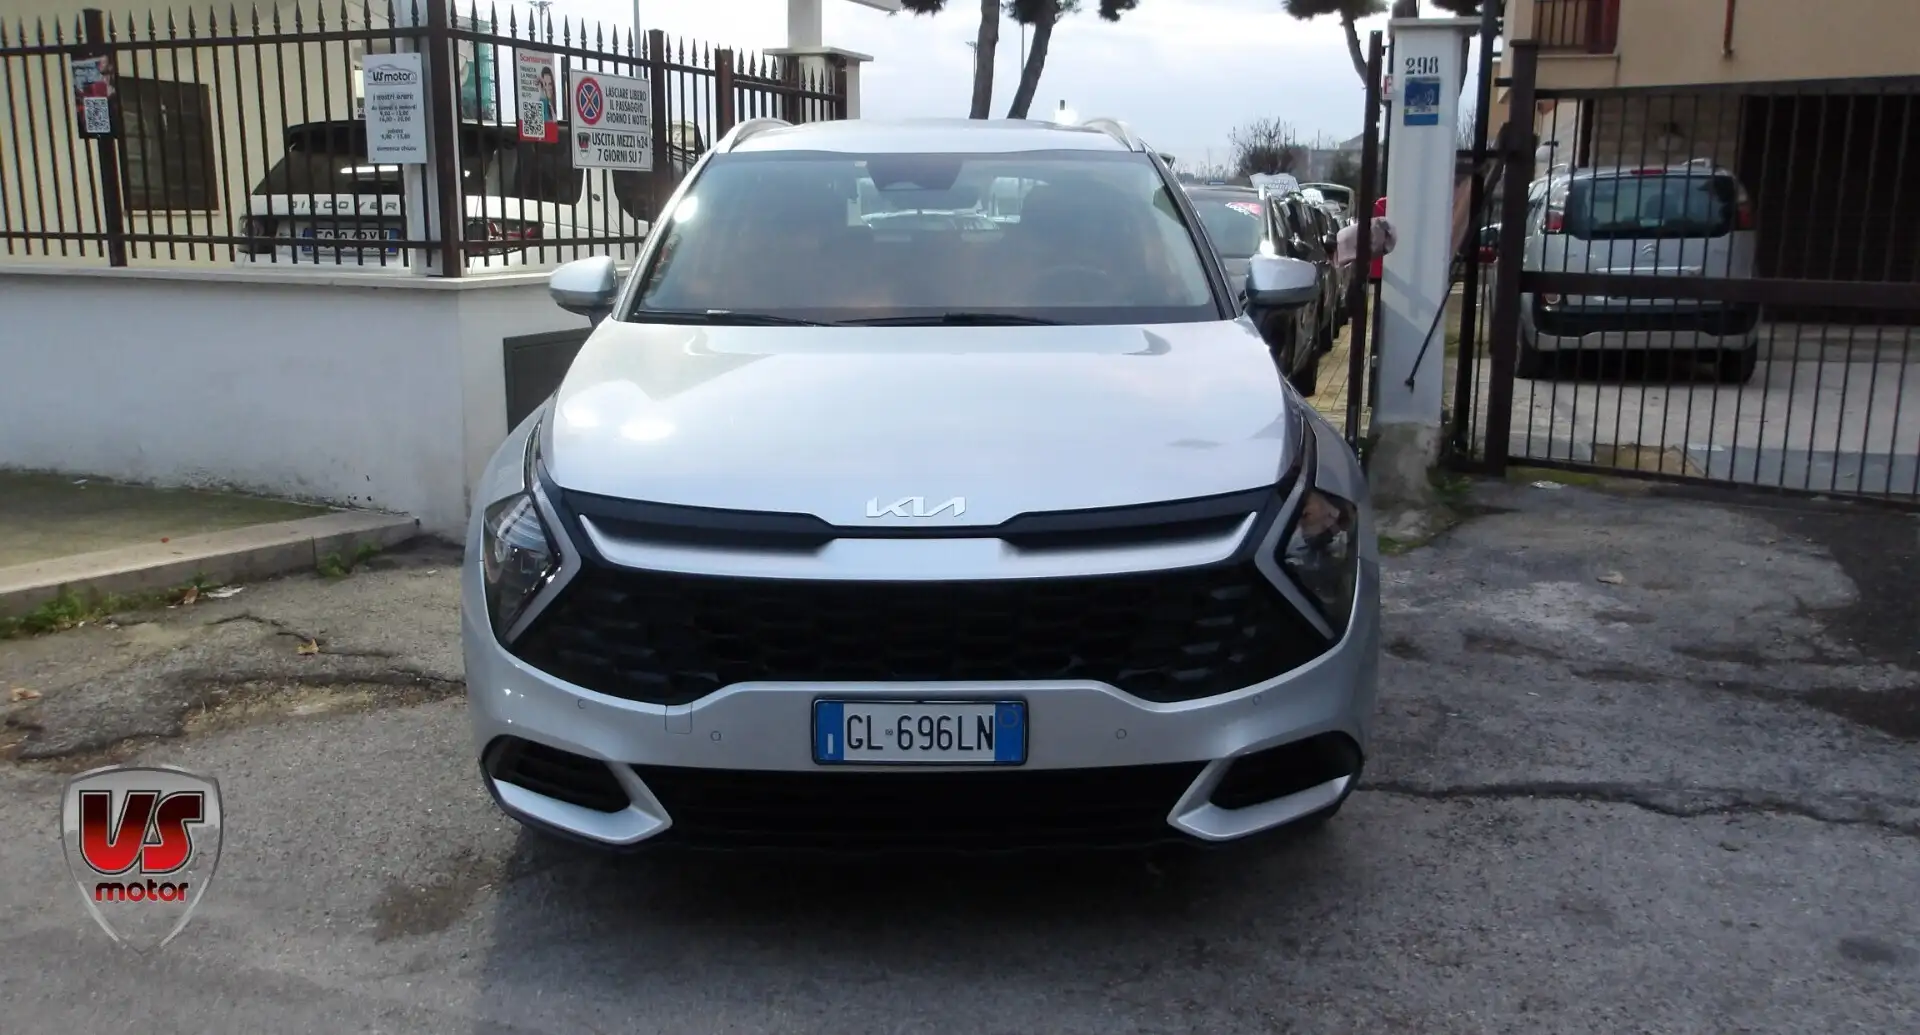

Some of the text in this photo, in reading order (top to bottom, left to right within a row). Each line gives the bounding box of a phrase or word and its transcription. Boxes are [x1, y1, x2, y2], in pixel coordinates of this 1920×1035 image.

[1405, 56, 1439, 75] 298
[605, 86, 647, 101] LASCIARE LIBERO
[609, 100, 644, 113] IL PASSAGGIO
[606, 112, 647, 126] GIORNO E NOTTE
[592, 132, 648, 148] USCITA MEZZI h24
[597, 149, 643, 163] 7 GIORNI SU 7
[866, 496, 966, 518] KIA
